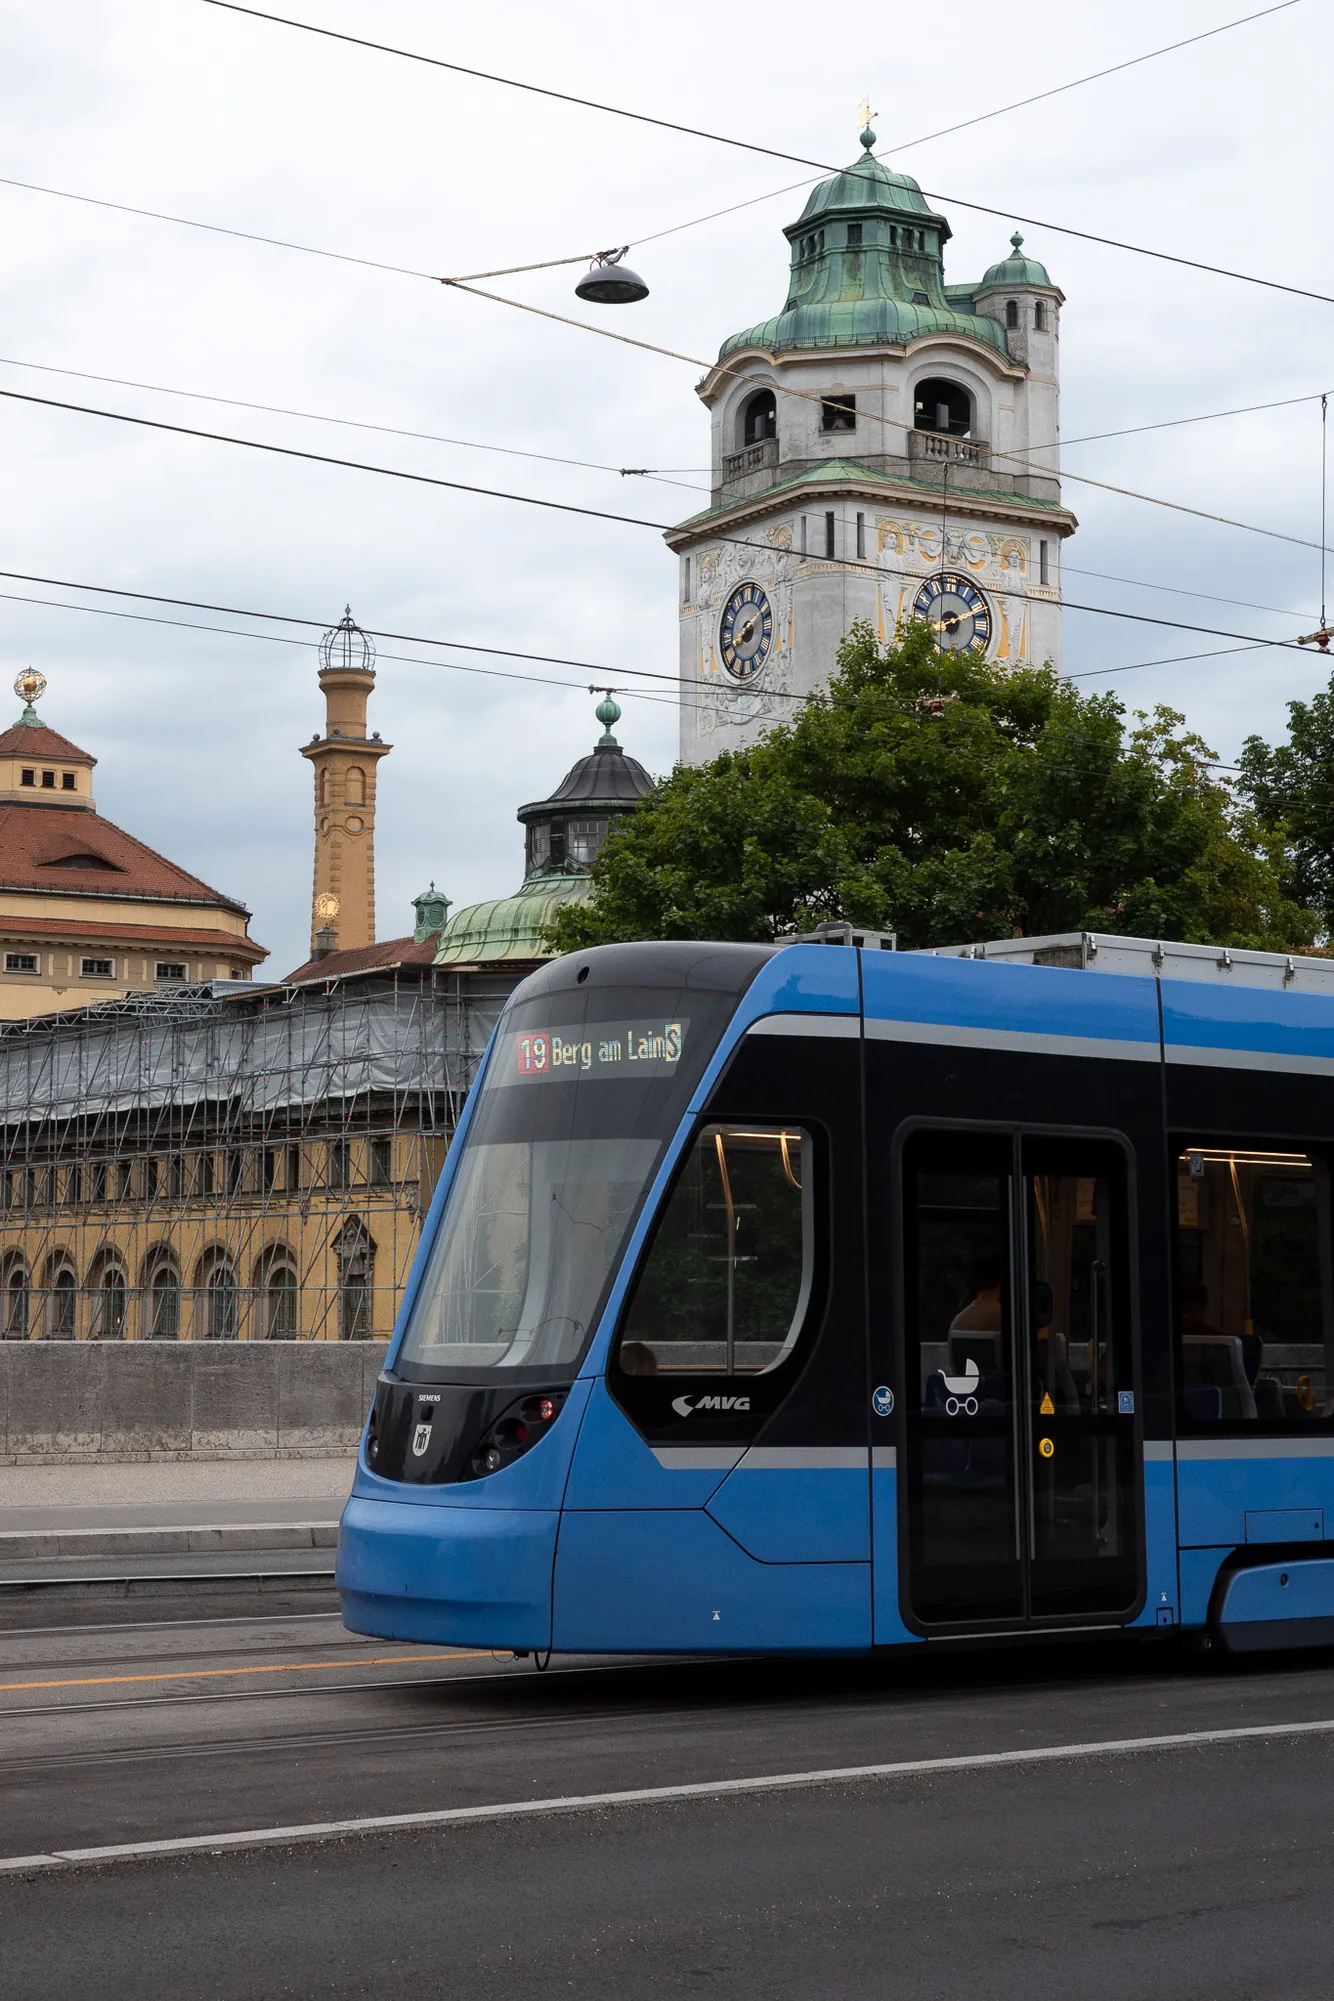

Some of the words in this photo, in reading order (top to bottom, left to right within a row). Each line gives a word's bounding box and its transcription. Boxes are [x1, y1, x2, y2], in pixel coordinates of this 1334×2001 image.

[961, 586, 970, 598] I
[763, 619, 772, 630] III
[974, 620, 987, 631] III
[520, 1038, 546, 1069] 19
[552, 1037, 592, 1070] Berg
[598, 1040, 621, 1061] am
[627, 1030, 667, 1060] Laim
[418, 1394, 441, 1402] SIEMENS
[694, 1395, 750, 1410] MVG
